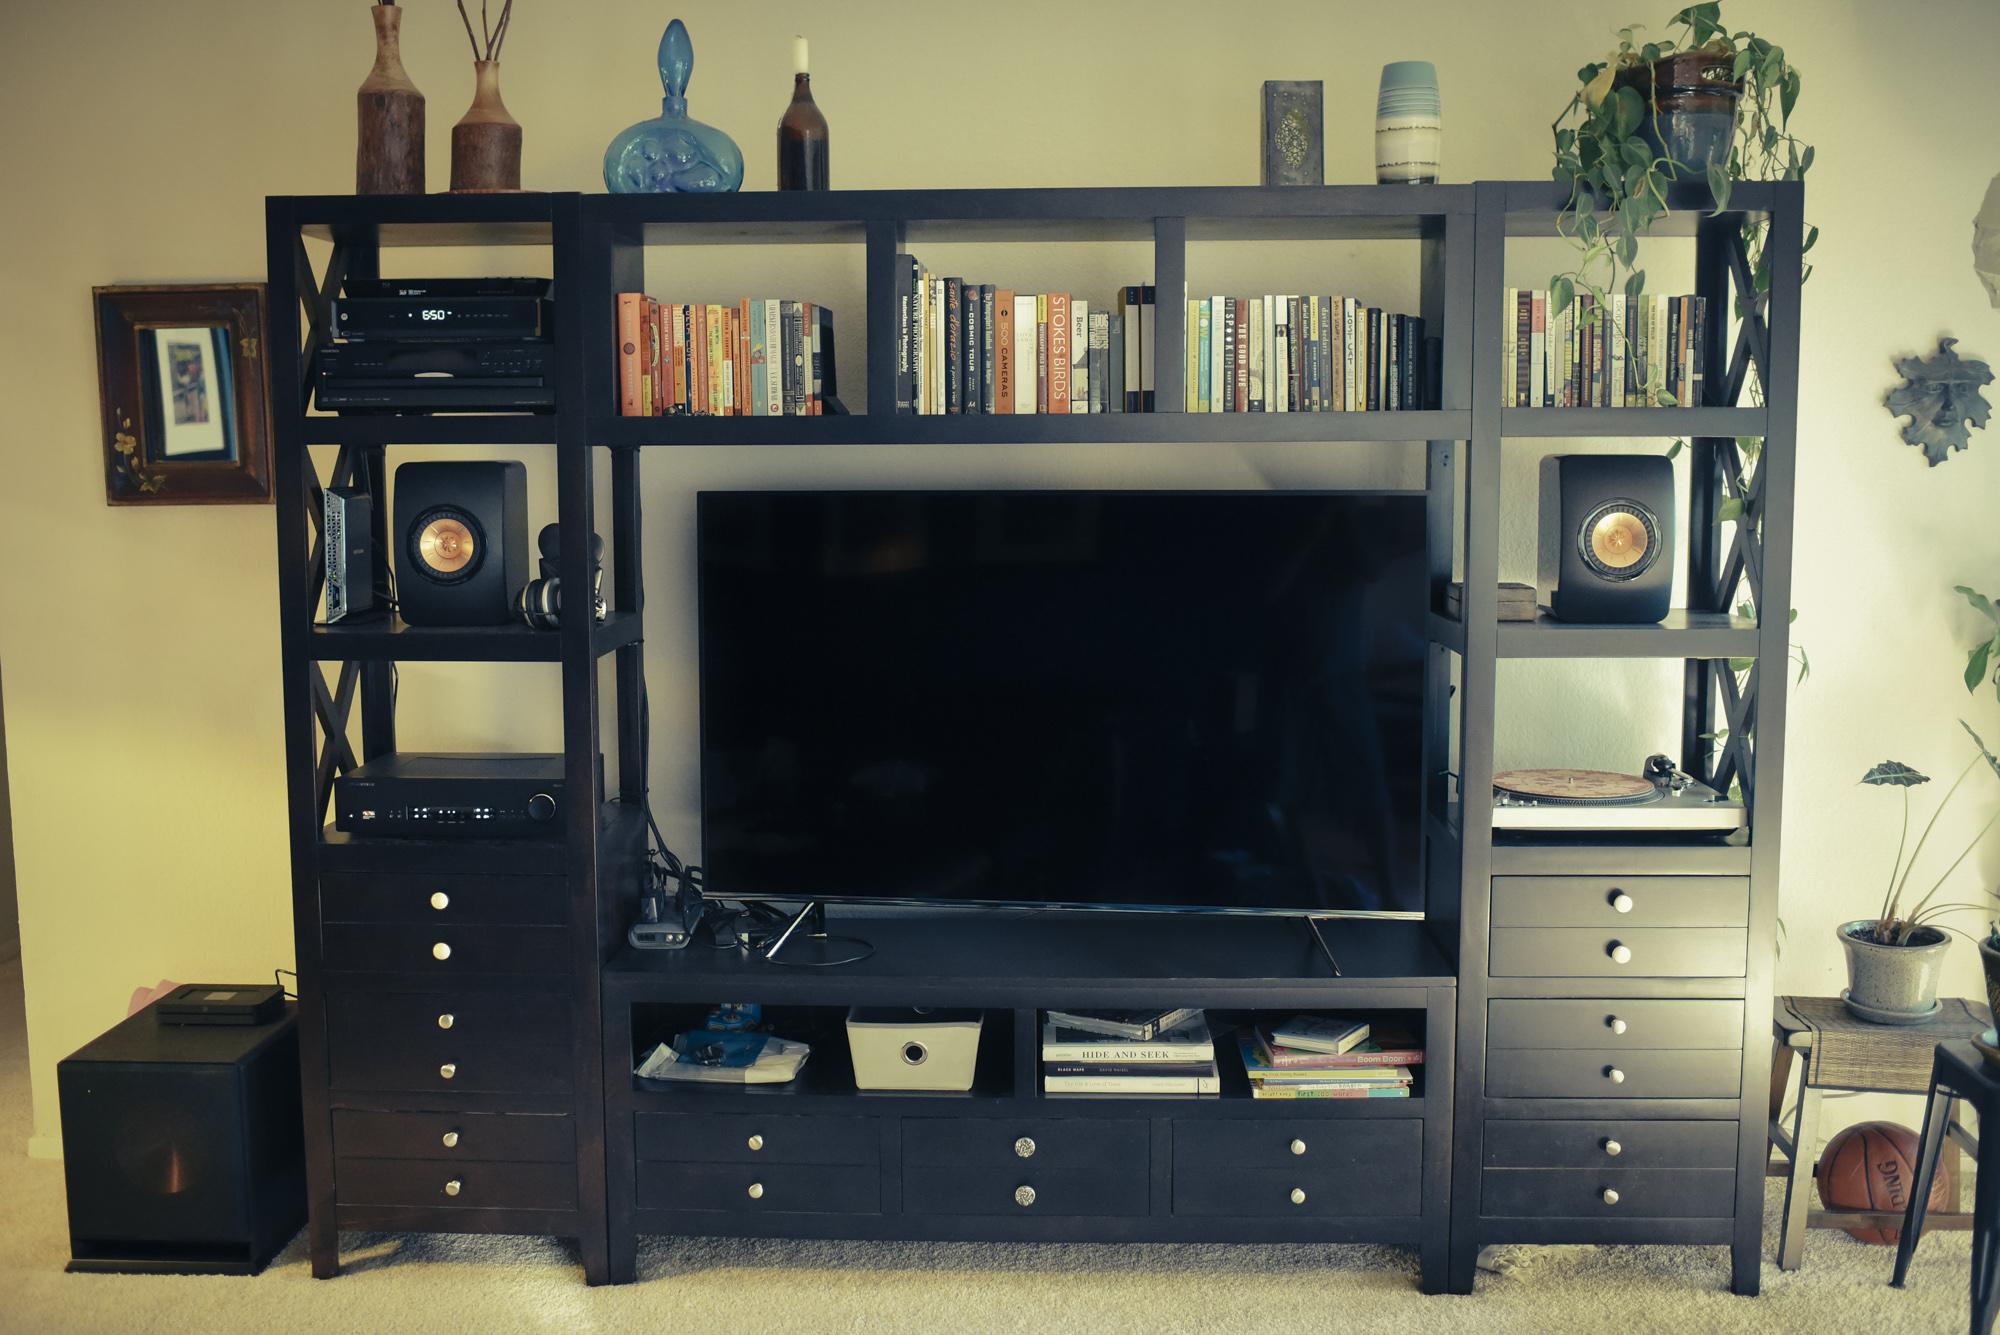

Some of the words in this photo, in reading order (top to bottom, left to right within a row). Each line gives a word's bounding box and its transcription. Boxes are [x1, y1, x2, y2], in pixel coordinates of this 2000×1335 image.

[911, 294, 919, 321] NATURE
[1001, 322, 1009, 346] 500
[1053, 297, 1066, 354] STOKES
[1076, 316, 1084, 338] Beer
[1238, 323, 1247, 340] THE
[900, 335, 909, 373] Photography
[911, 323, 919, 373] PHOTOGRAPHY
[1238, 344, 1247, 366] GOOD
[1001, 347, 1009, 398] CAMERAS
[1053, 358, 1066, 400] BIRDS
[1238, 369, 1247, 388] LIFE
